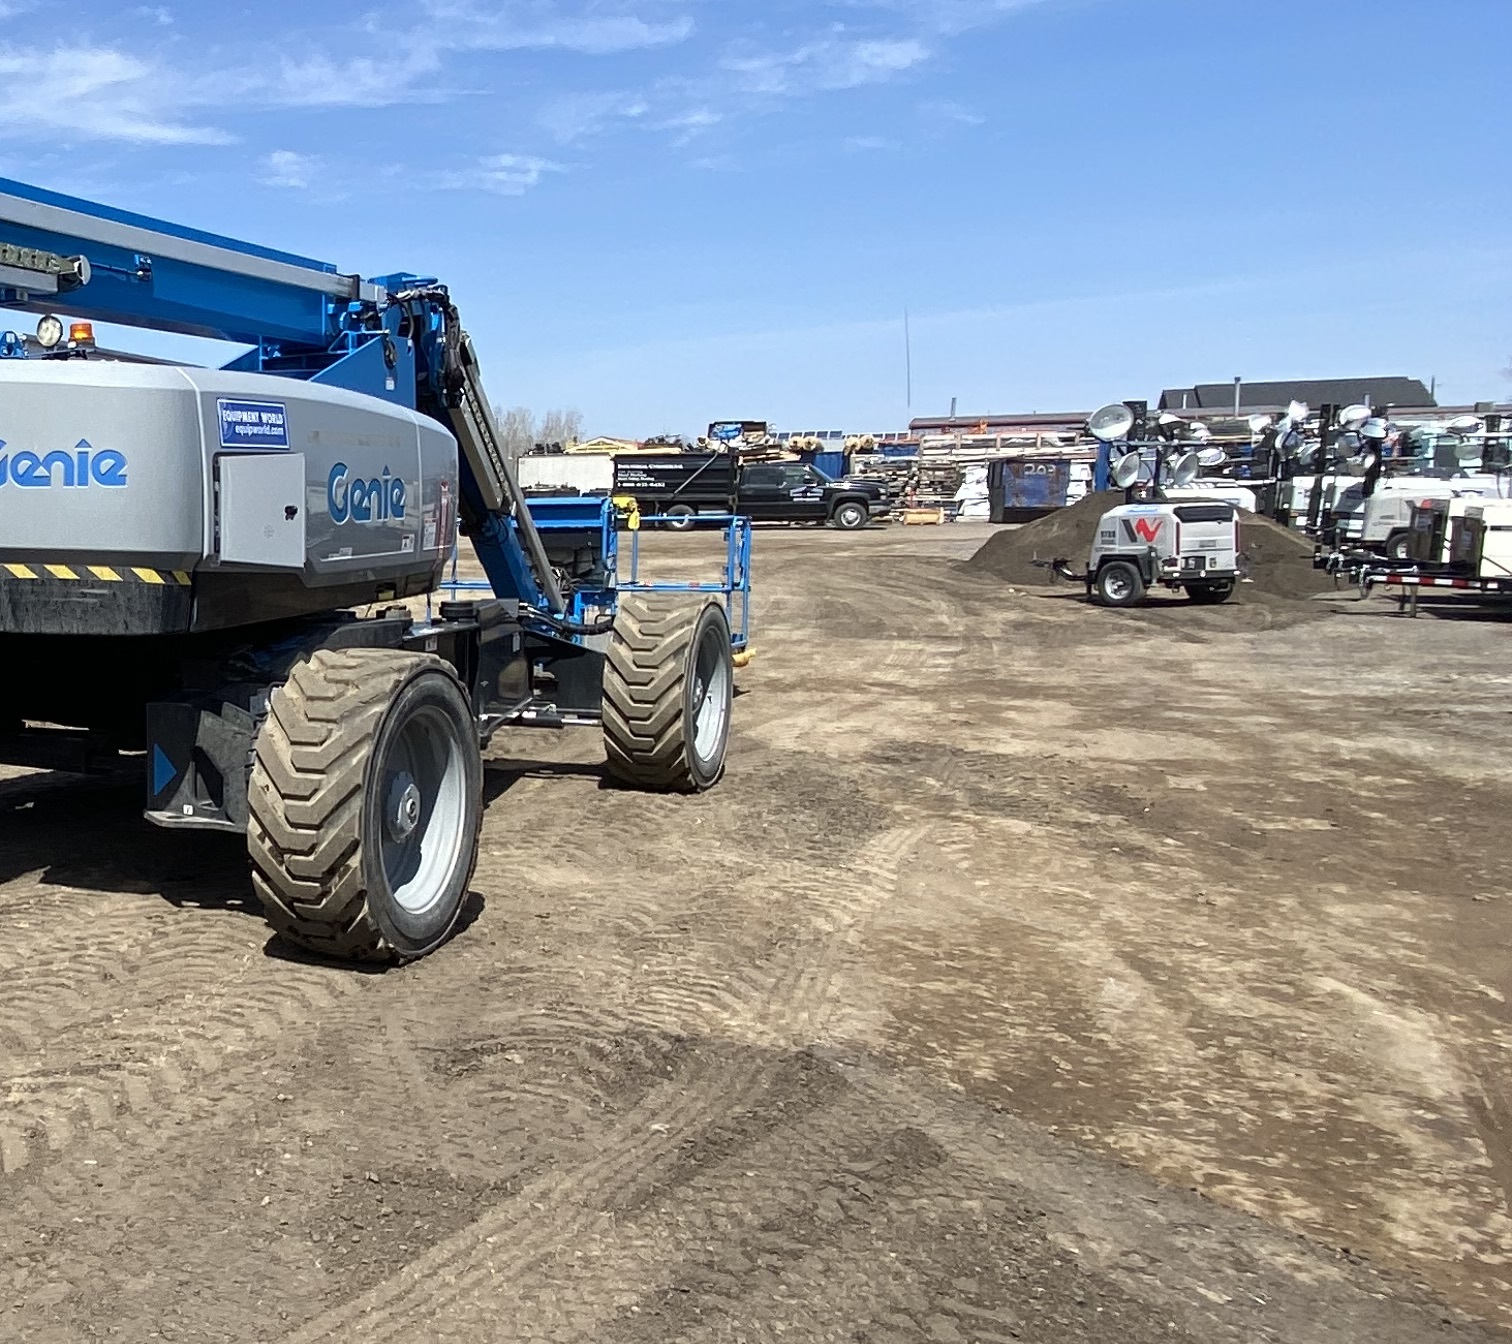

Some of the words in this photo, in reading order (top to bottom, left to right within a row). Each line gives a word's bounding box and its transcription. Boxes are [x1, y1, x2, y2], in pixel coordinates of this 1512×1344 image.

[222, 410, 259, 423] EQUIPMENT
[260, 412, 284, 425] WORLD
[235, 423, 284, 437] equipworld.com
[328, 461, 406, 525] Genie
